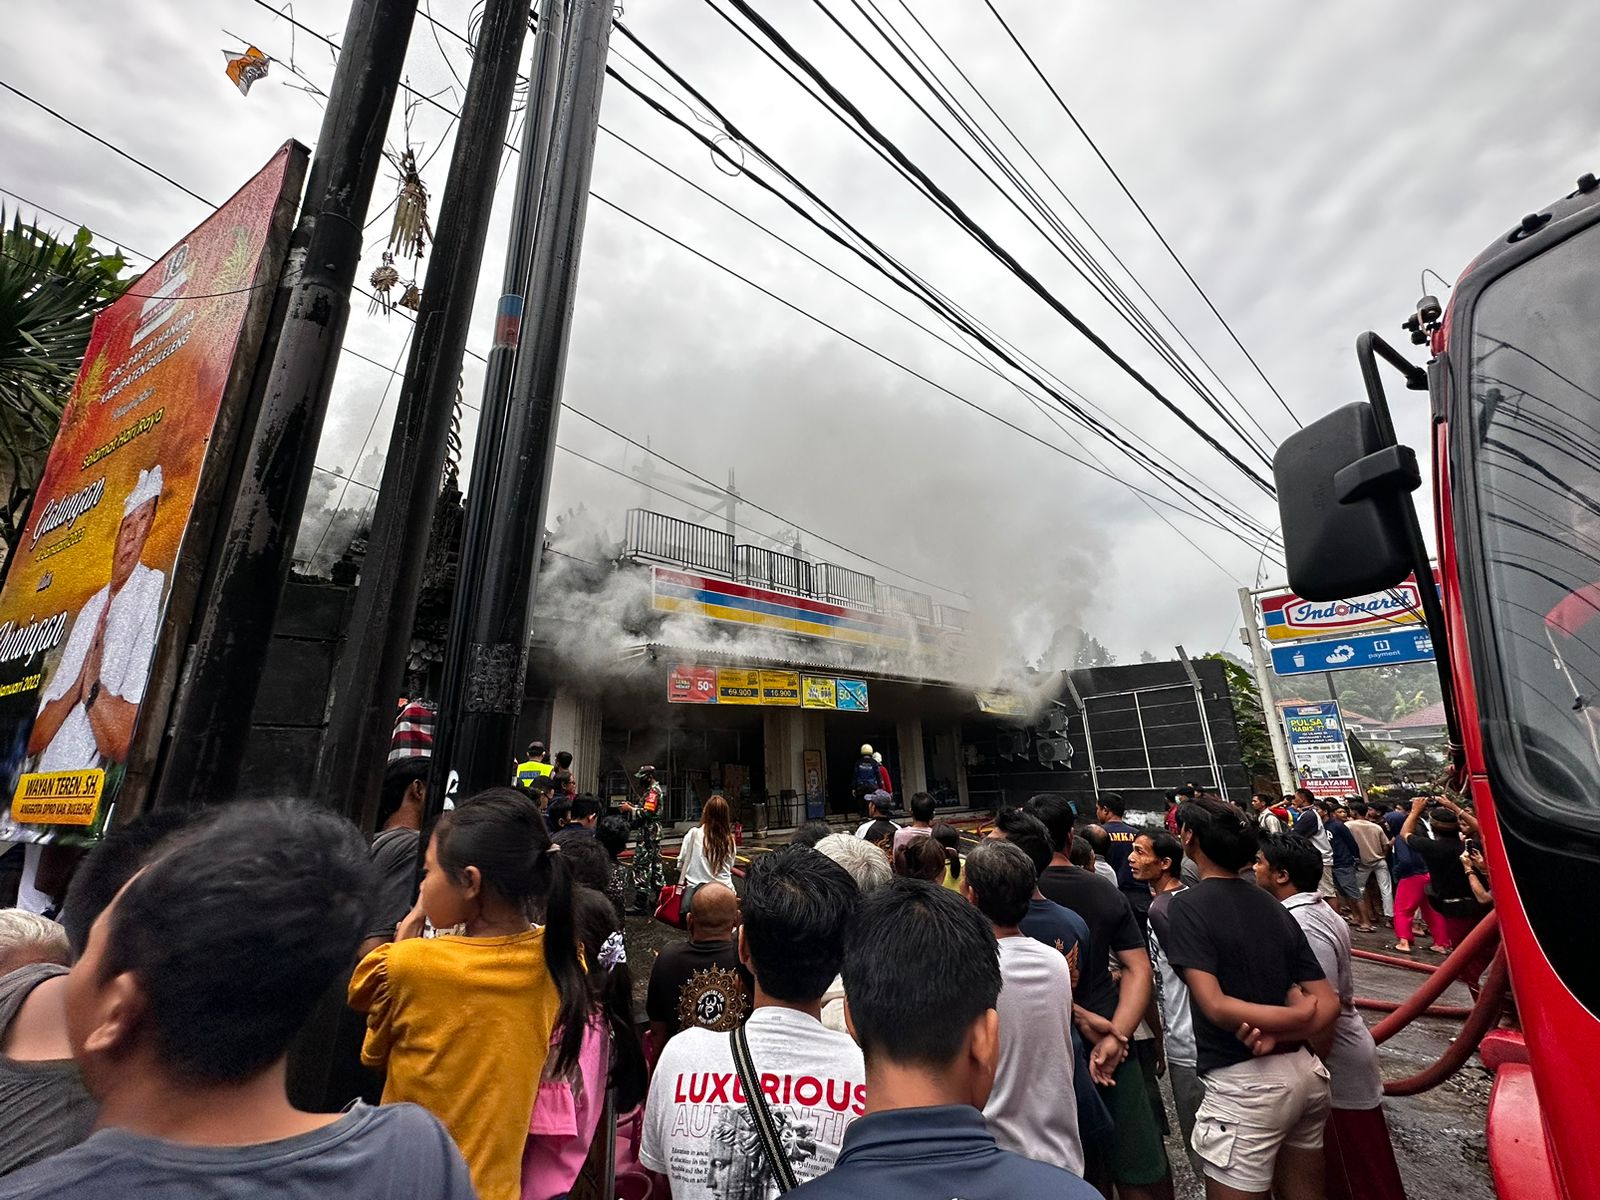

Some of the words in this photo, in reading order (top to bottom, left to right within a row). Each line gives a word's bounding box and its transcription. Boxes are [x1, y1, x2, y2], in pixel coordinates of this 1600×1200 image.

[31, 475, 106, 551] Galungan
[1295, 591, 1409, 622] Indomaret
[1368, 650, 1401, 659] payment
[22, 673, 41, 692] 2023
[728, 689, 752, 697] 69.900
[1290, 718, 1323, 727] PULSA
[25, 778, 55, 797] WAYAN
[674, 1072, 866, 1117] LUXURIOUS
